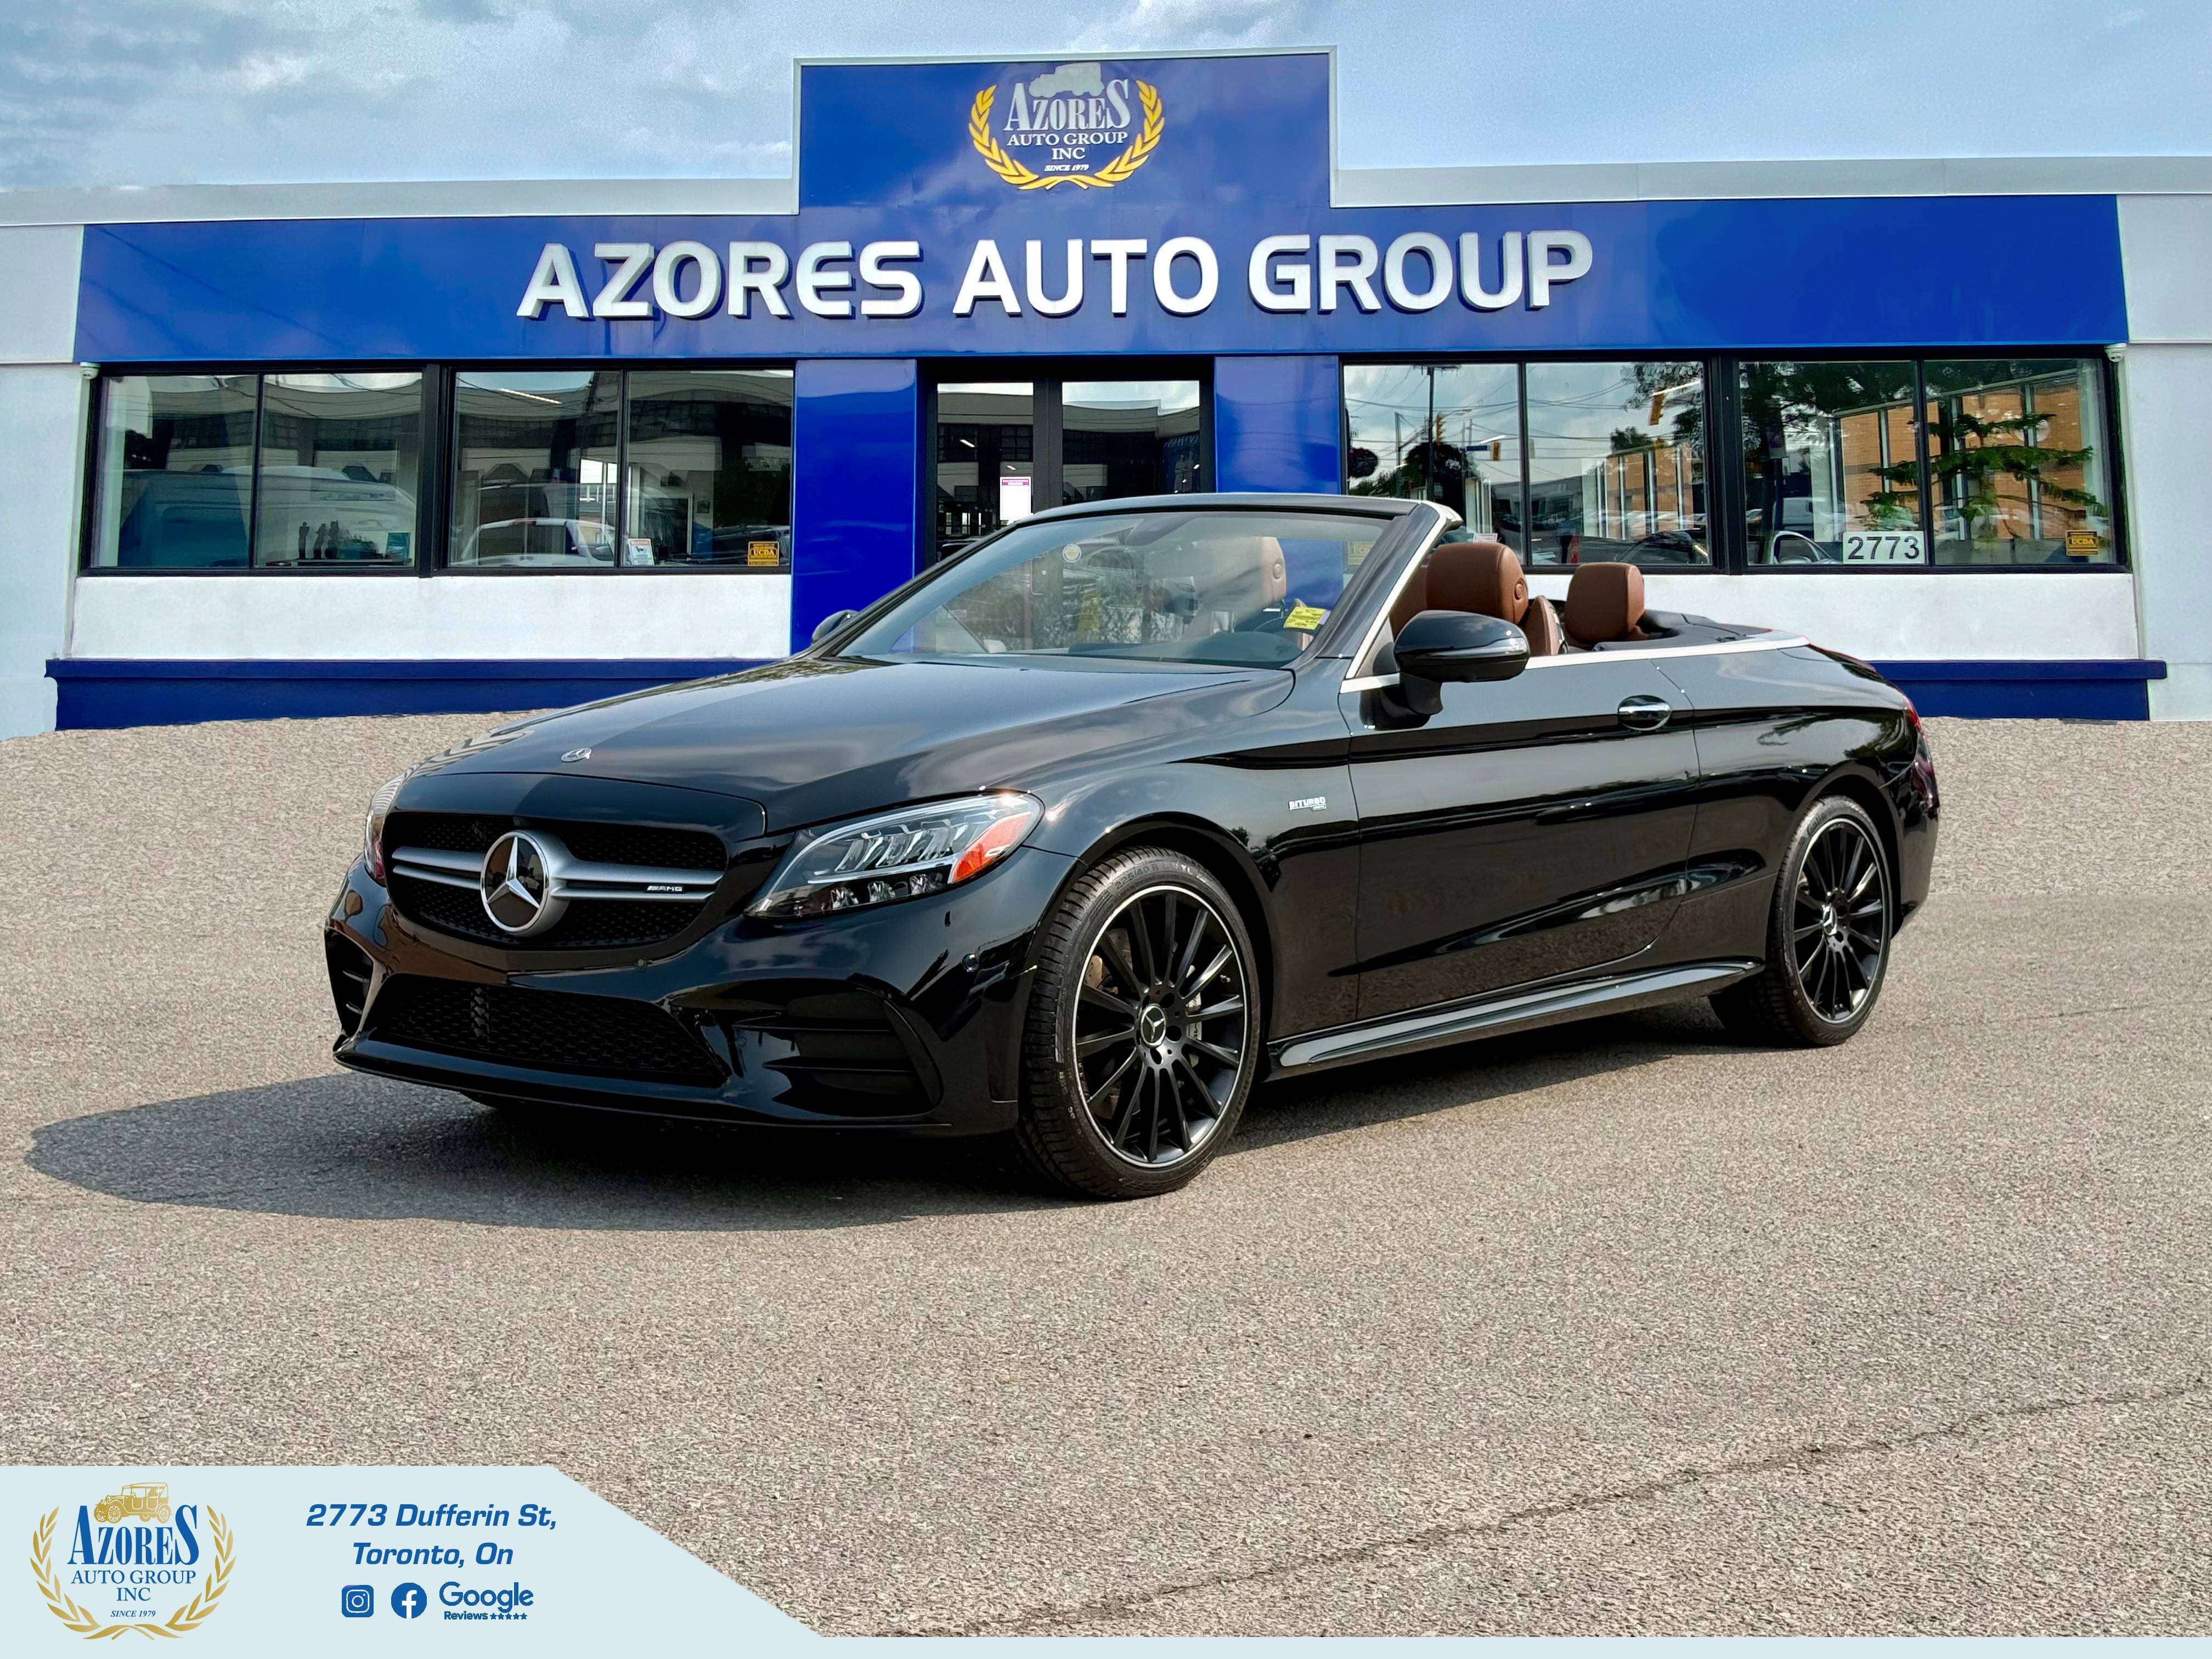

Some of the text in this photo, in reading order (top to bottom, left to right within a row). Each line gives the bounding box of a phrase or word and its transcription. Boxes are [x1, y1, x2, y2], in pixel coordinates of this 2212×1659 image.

[1003, 78, 1132, 131] AZORES
[1007, 132, 1128, 146] AUTO GROUP
[1052, 148, 1086, 160] INC
[517, 230, 1593, 318] AZORES AUTO GROUP
[1847, 536, 1920, 560] 2773
